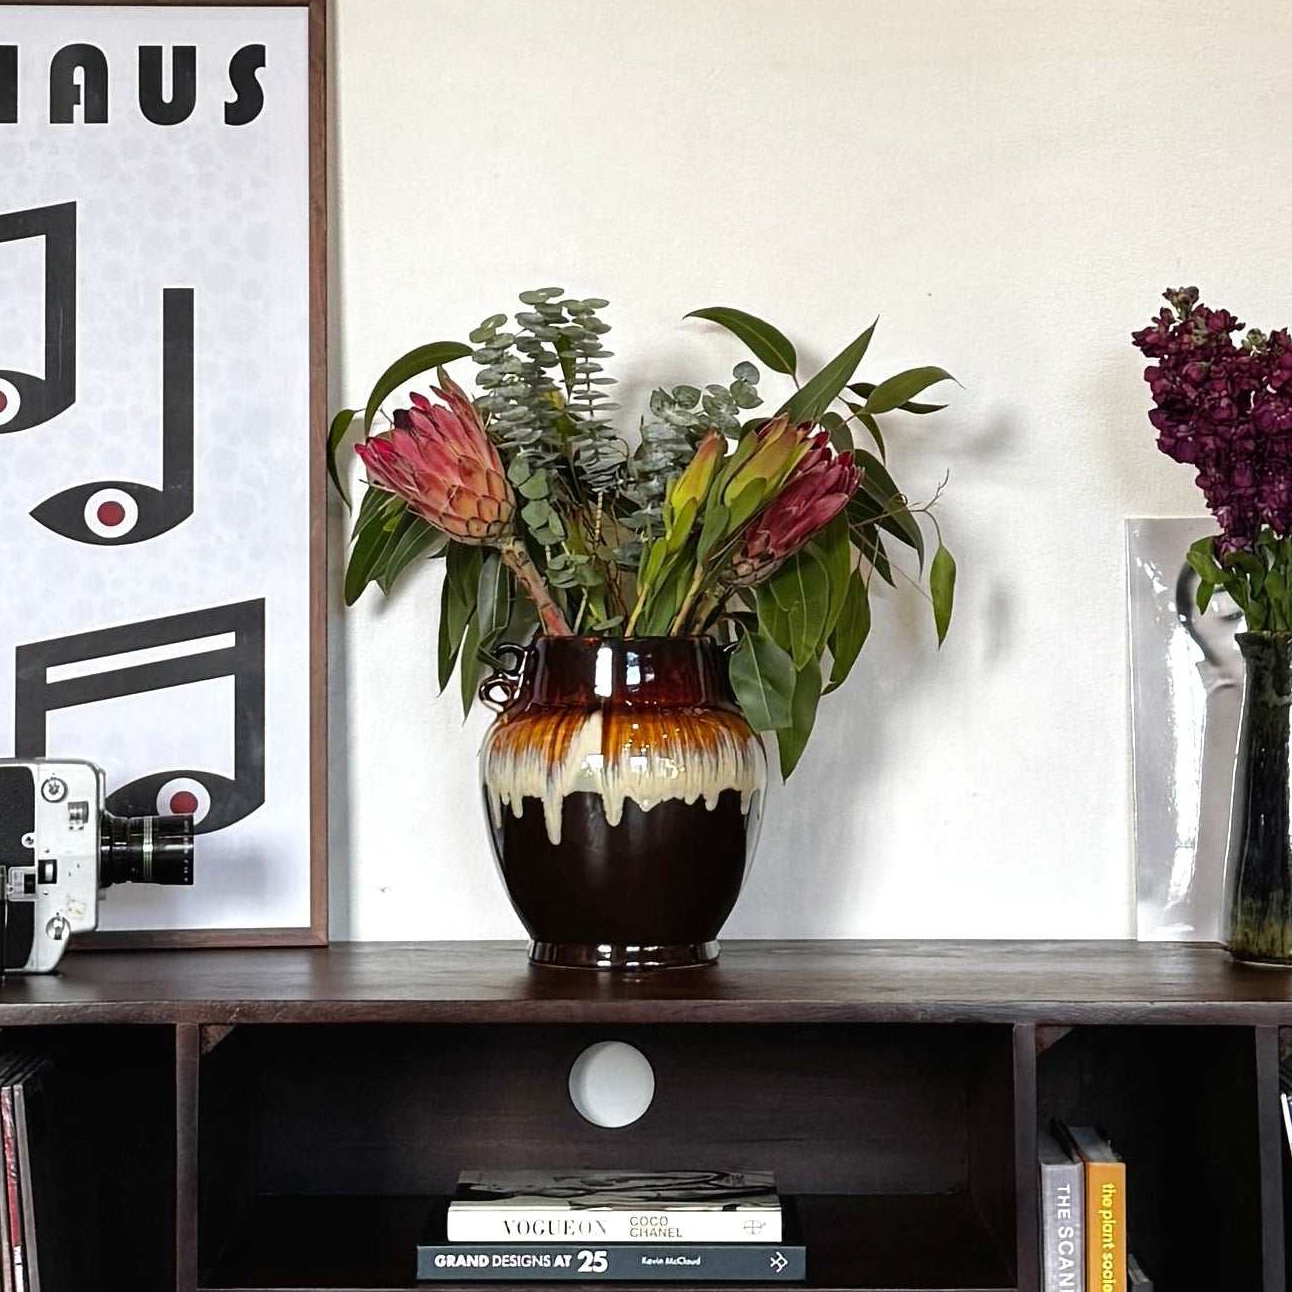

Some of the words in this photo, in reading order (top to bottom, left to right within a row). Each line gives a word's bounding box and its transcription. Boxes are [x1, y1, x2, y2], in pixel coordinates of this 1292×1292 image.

[1057, 1183, 1071, 1219] THE
[1102, 1183, 1116, 1207] the
[504, 1220, 575, 1235] VOGUE
[579, 1220, 607, 1235] ON
[630, 1216, 668, 1226] COCO
[1098, 1210, 1116, 1249] plant
[630, 1227, 682, 1238] CHANEL
[434, 1255, 489, 1268] GRAND
[492, 1255, 551, 1268] DESIGNS
[554, 1255, 572, 1268] AT
[577, 1250, 608, 1273] 25
[642, 1257, 664, 1265] Kevin
[666, 1257, 701, 1266] McCloud
